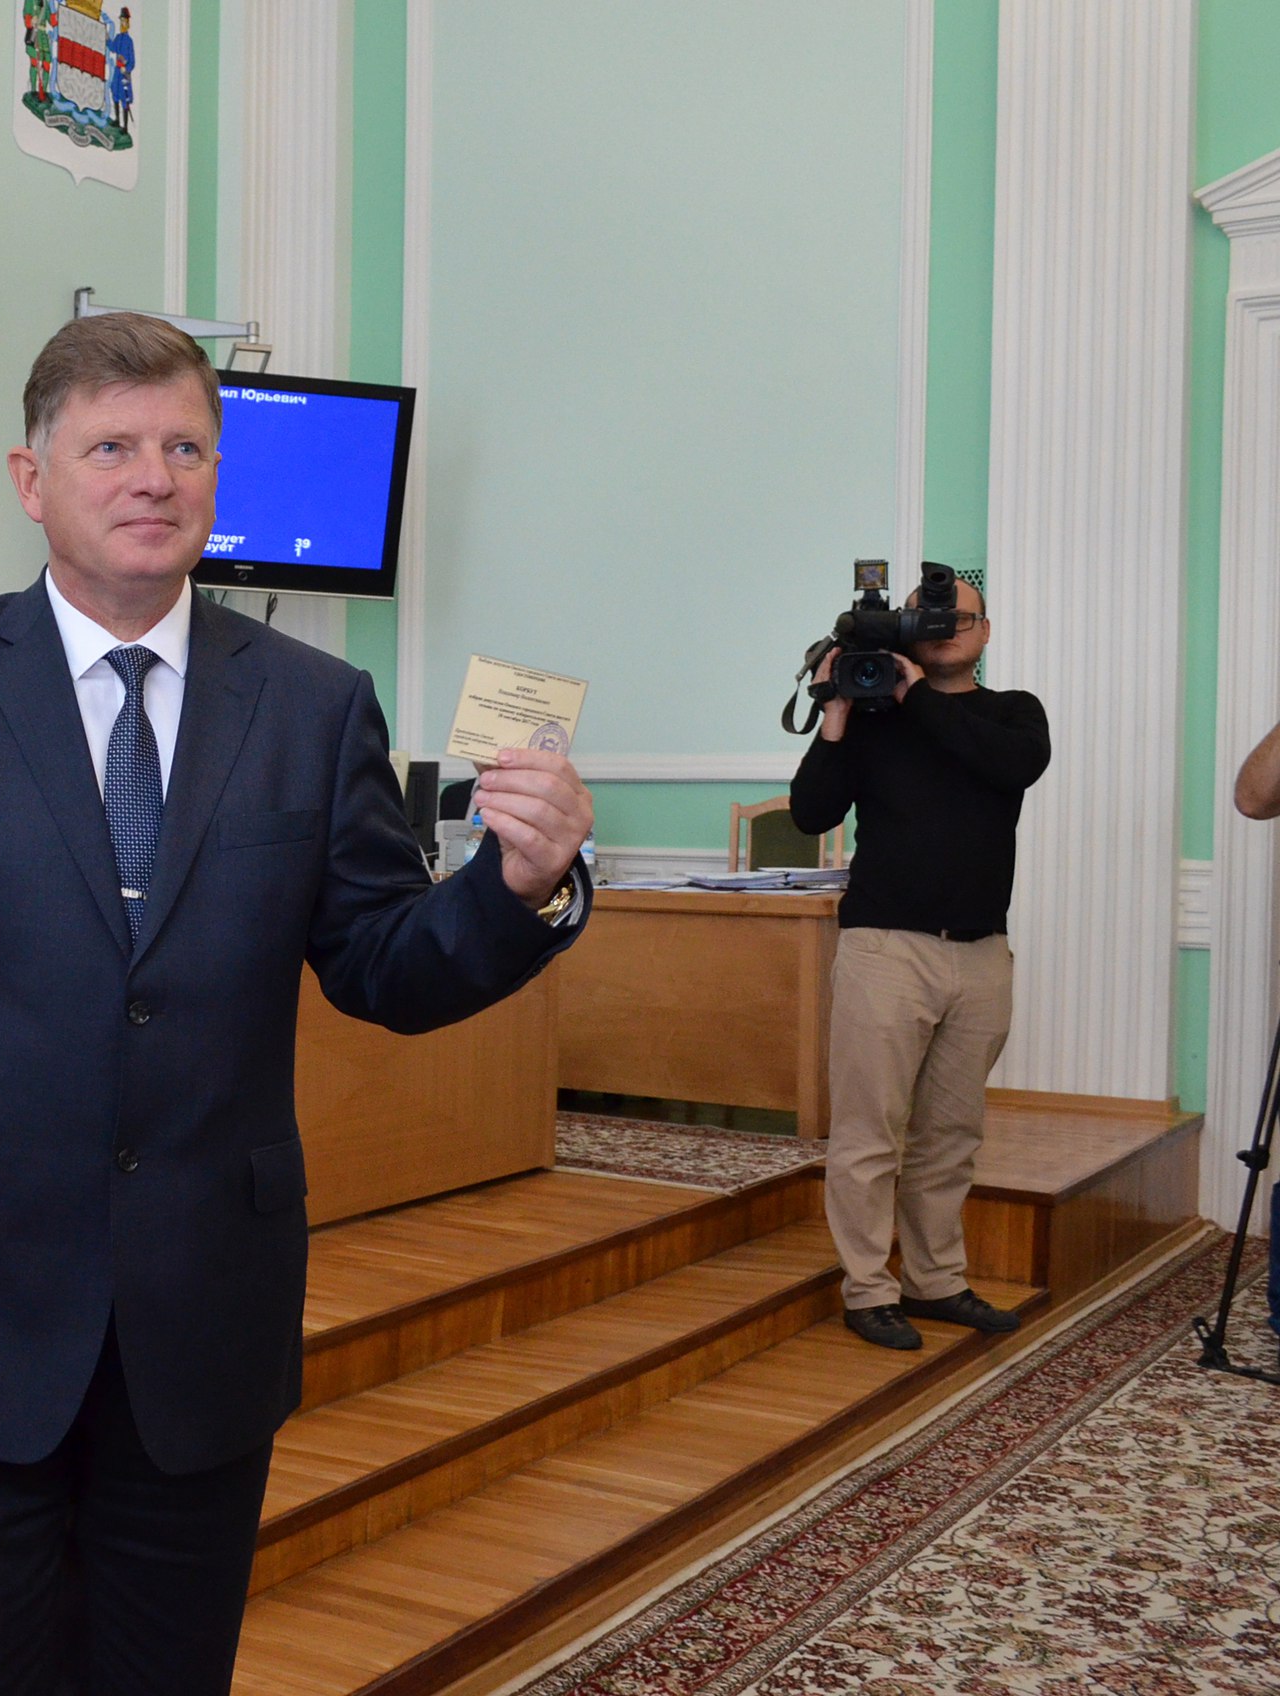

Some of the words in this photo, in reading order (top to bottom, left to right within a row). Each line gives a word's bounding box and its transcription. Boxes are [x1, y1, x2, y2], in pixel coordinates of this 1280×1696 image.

[241, 388, 307, 405] Юрьевич
[294, 537, 311, 549] 39
[294, 547, 302, 557] 1
